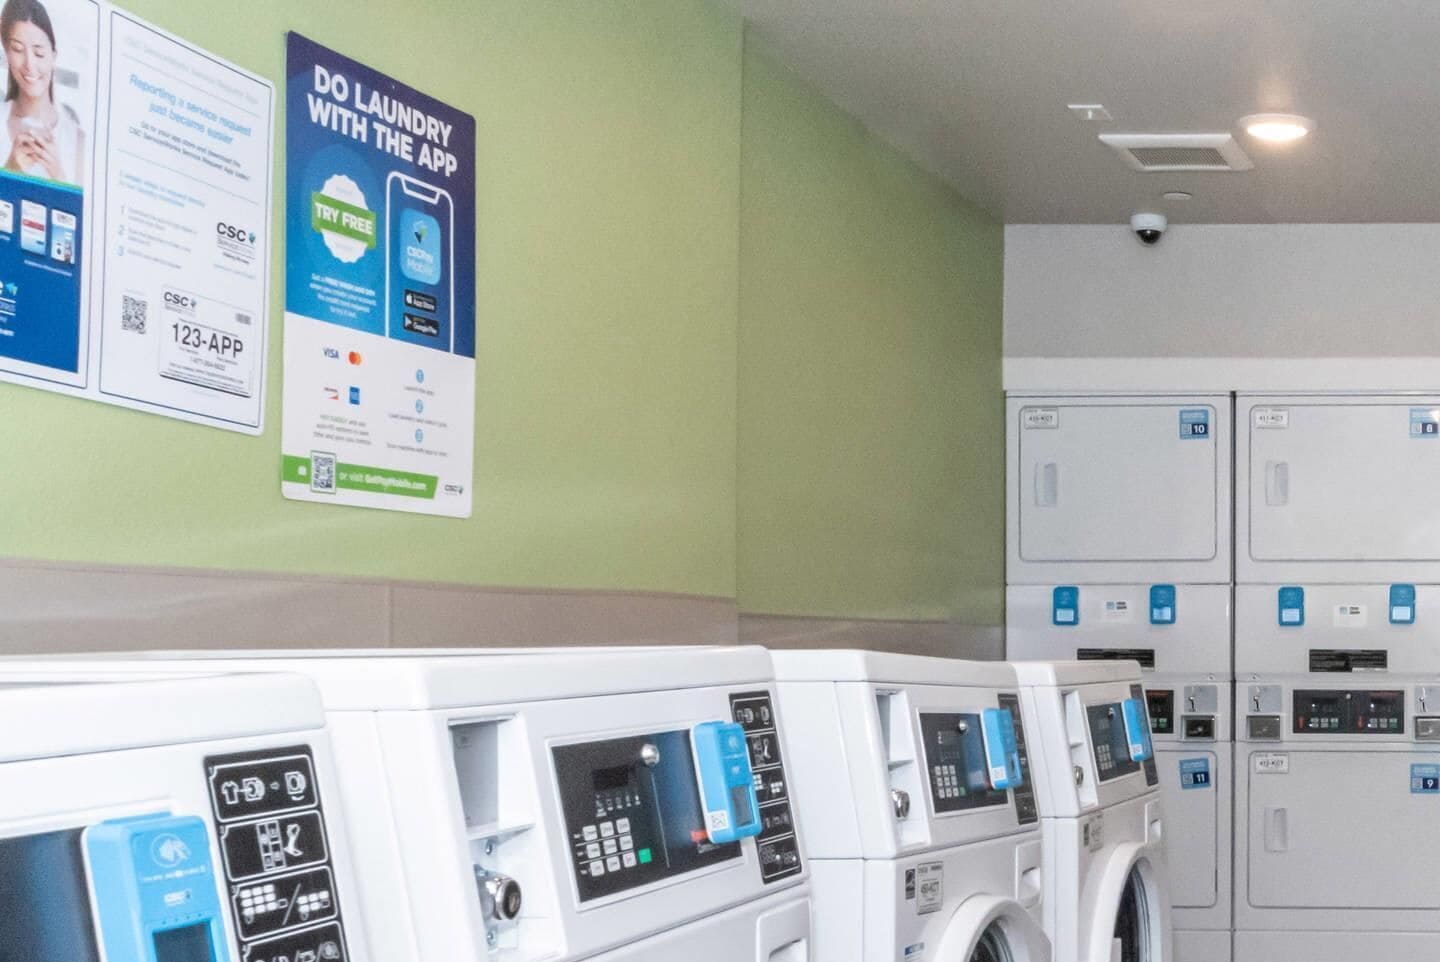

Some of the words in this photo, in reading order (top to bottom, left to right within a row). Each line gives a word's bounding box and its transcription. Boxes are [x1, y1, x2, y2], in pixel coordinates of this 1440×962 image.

[313, 64, 349, 102] DO
[355, 82, 452, 147] LAUNDRY
[307, 93, 367, 143] WITH
[372, 121, 413, 162] THE
[418, 143, 458, 177] APP
[314, 201, 342, 224] TRY
[342, 211, 374, 236] FREE
[216, 221, 247, 242] CSC
[163, 291, 189, 307] CSC
[172, 322, 244, 358] 123-APP
[322, 347, 339, 359] VISA
[1193, 425, 1205, 433] 10
[1197, 774, 1205, 783] 11
[1427, 779, 1434, 788] 9
